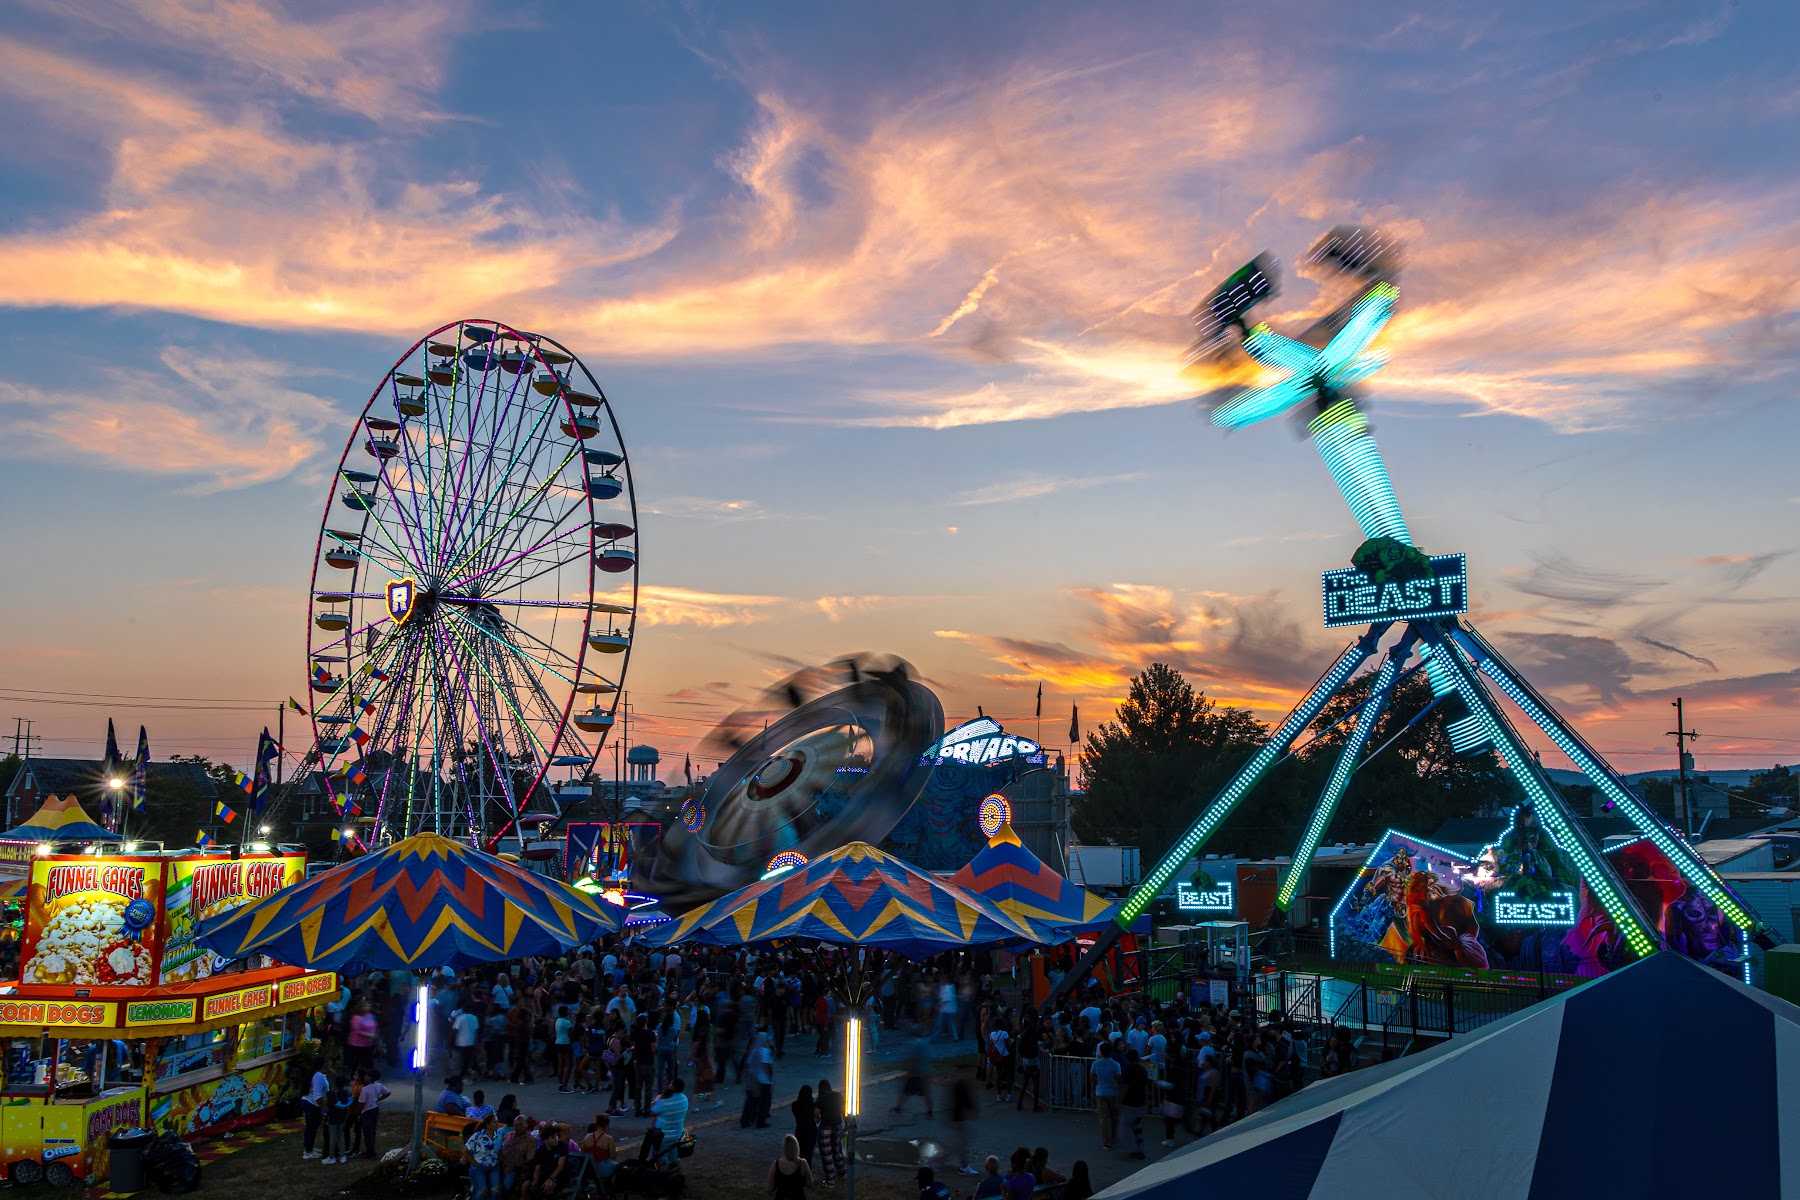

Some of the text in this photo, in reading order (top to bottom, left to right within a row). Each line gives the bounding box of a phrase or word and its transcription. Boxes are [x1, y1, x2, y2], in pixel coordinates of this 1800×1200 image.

[1328, 575, 1462, 617] BEAST
[46, 865, 145, 903] FUNNEL CAKES
[189, 862, 243, 919] FUNNEL
[1181, 891, 1228, 905] BEAST
[1499, 903, 1572, 919] BEAST
[162, 943, 207, 974] LEMONA
[283, 975, 333, 999] FRIED OREOS
[0, 1002, 105, 1024] ORN DOGS
[128, 1001, 193, 1022] LEMONADE
[206, 988, 269, 1017] FUNNEL CAKES
[87, 1098, 141, 1144] CORN DOGS
